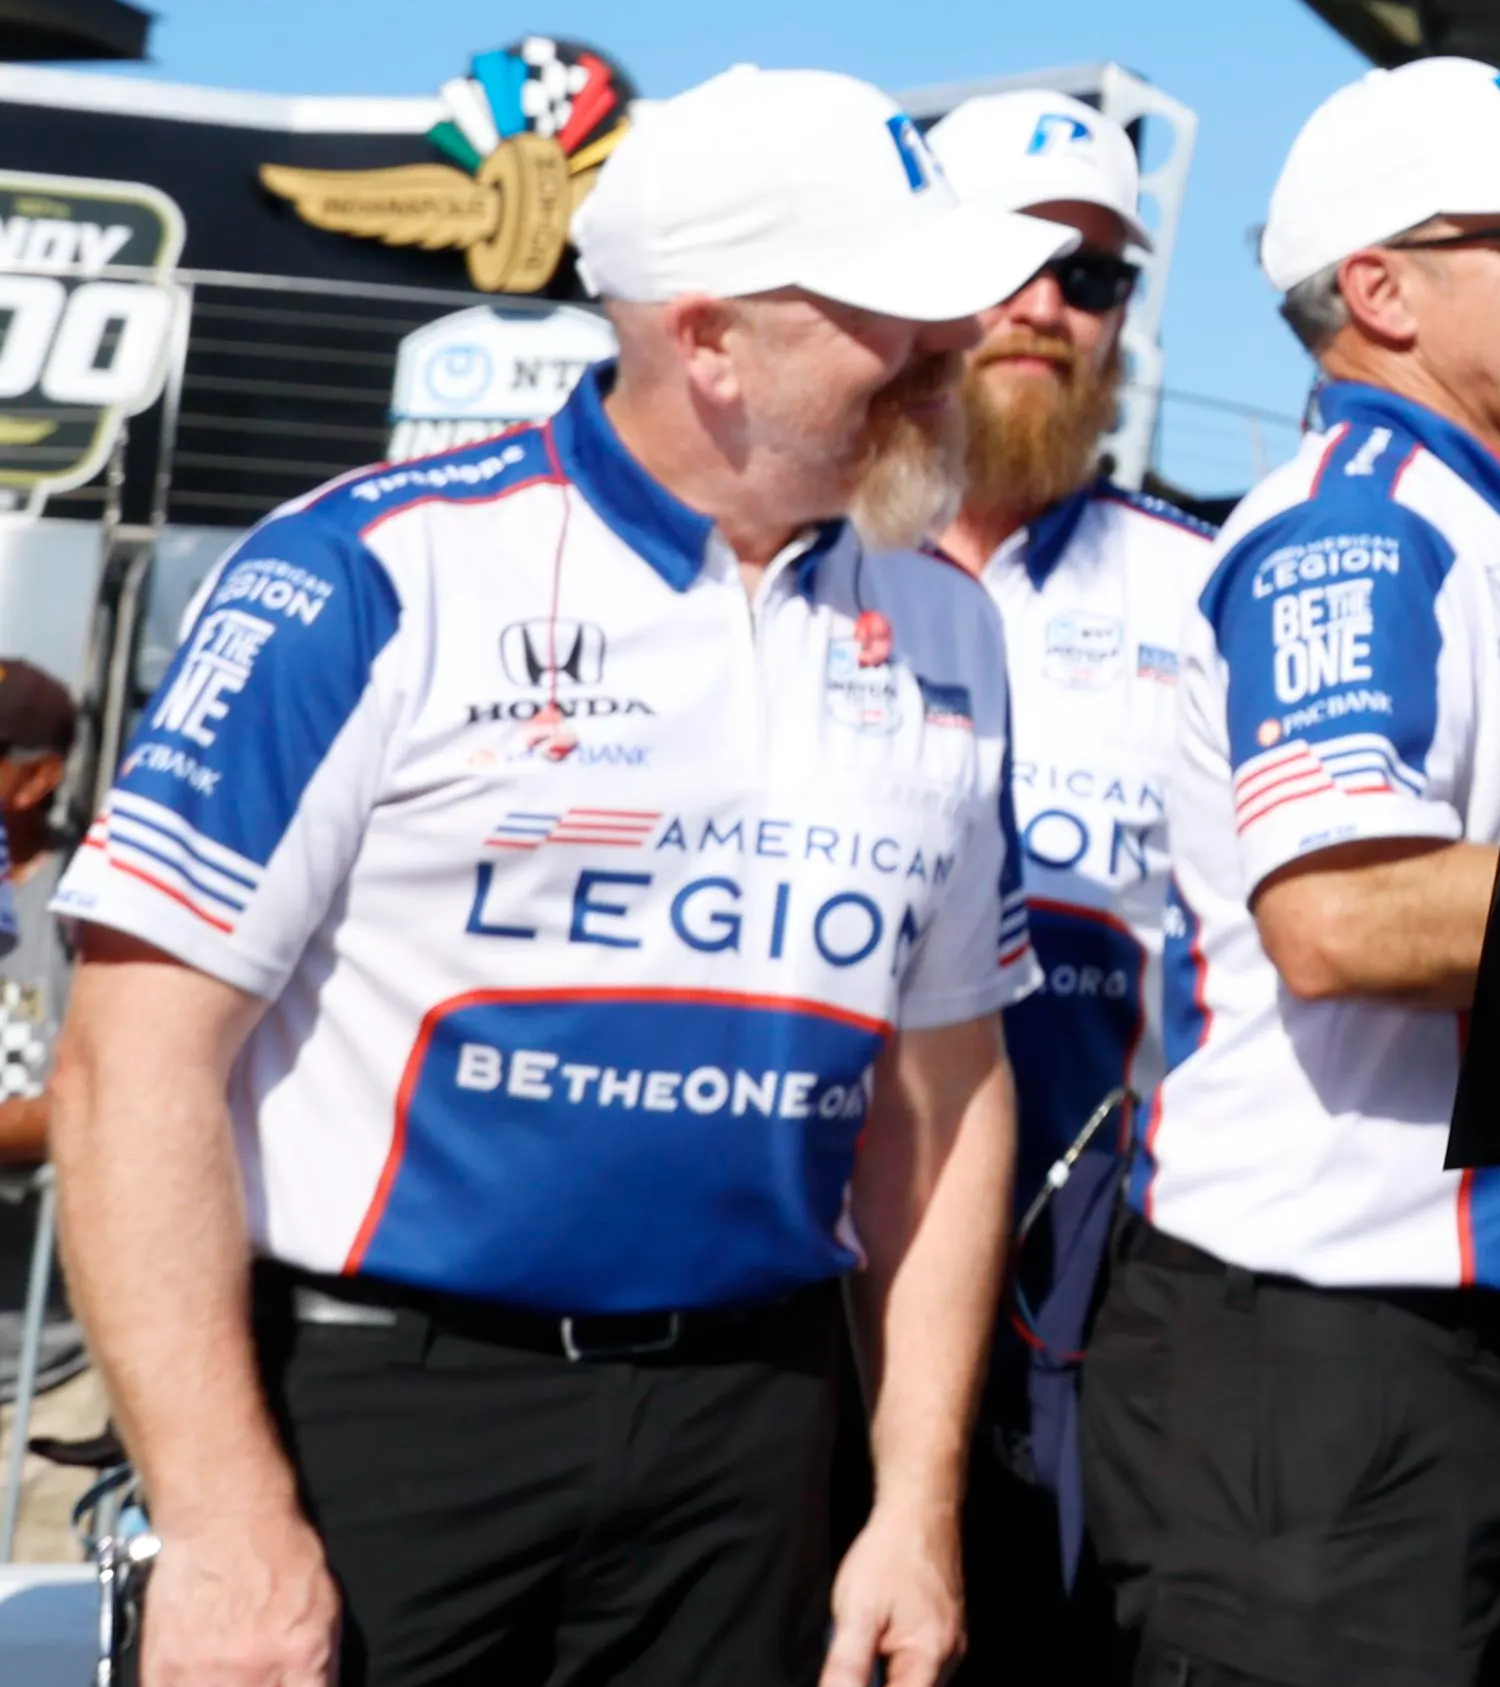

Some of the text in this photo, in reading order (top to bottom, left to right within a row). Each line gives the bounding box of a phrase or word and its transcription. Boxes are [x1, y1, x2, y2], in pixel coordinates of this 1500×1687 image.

[1253, 549, 1399, 599] LEGION
[1272, 586, 1326, 650] BE
[1275, 624, 1374, 704] ONE
[466, 696, 655, 725] HONDA
[656, 817, 955, 885] AMERICAN
